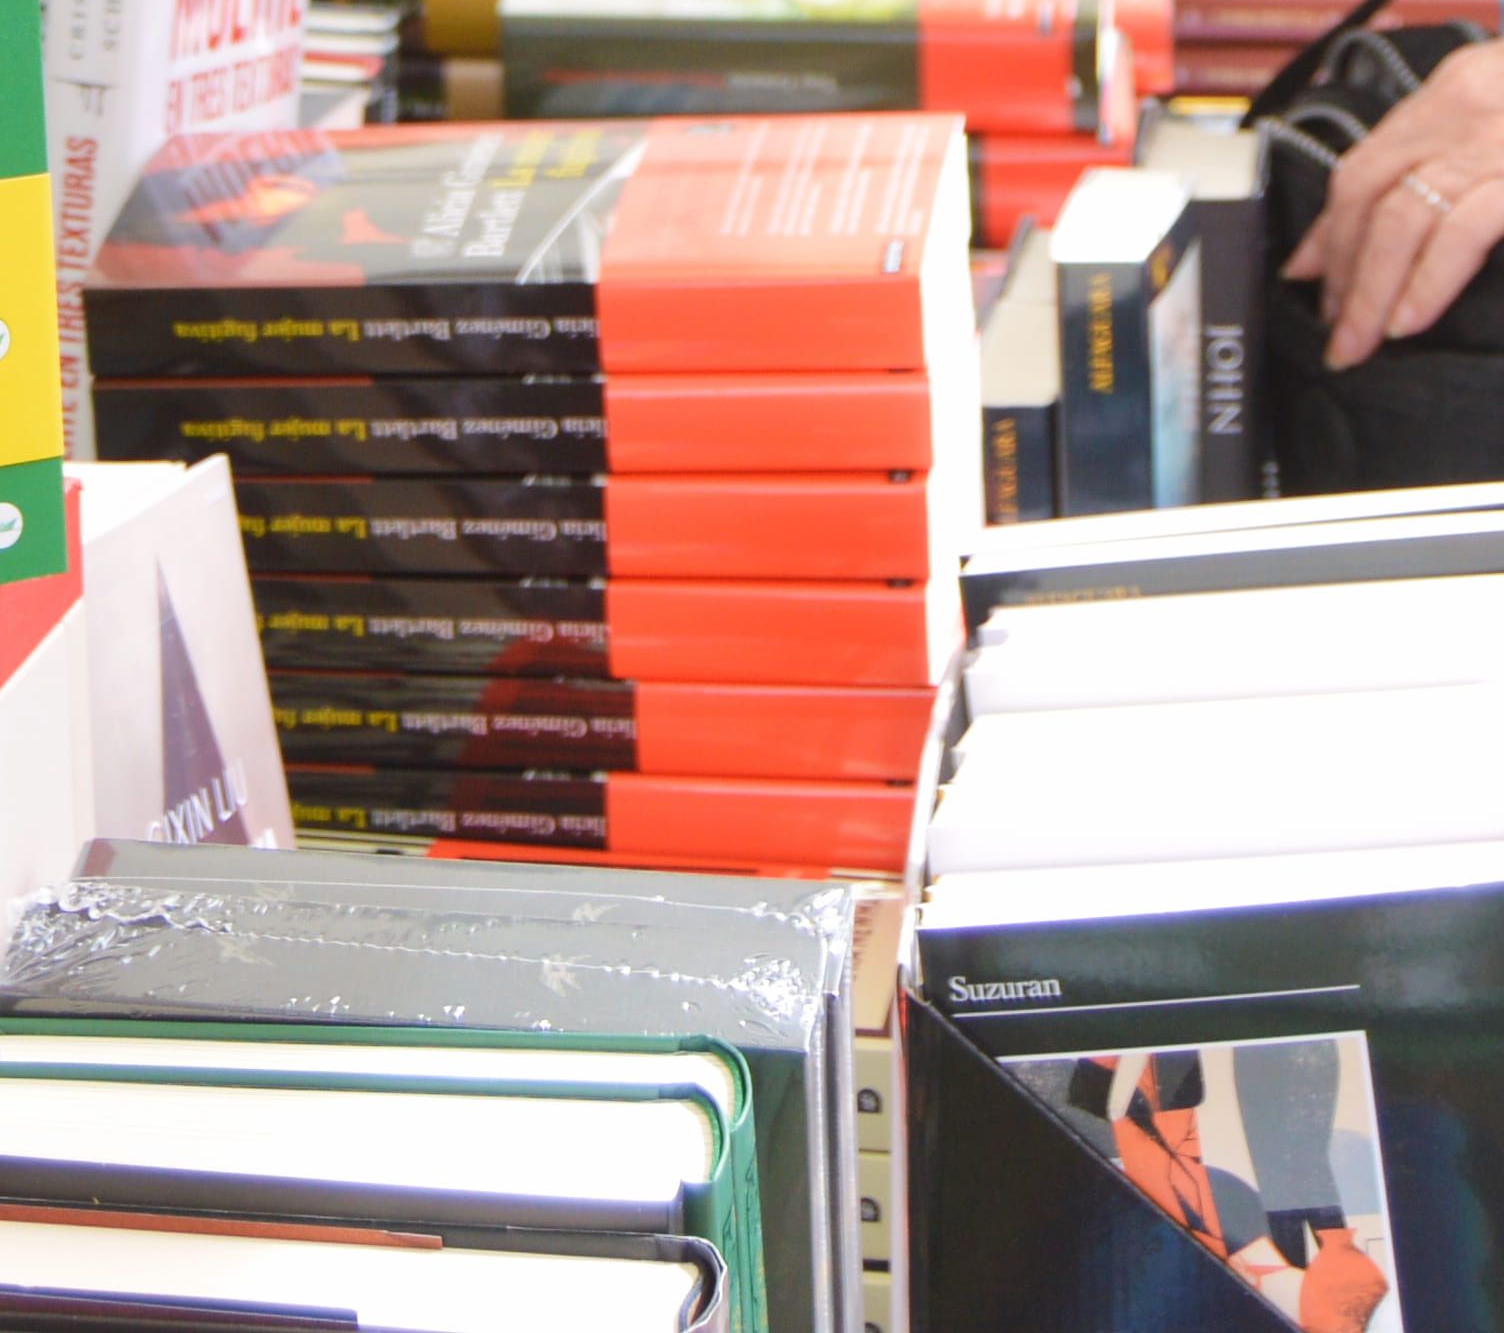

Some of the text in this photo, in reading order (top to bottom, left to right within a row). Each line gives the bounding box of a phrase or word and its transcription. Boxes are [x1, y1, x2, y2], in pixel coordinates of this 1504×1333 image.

[57, 137, 99, 272] TEXTURAS
[56, 283, 84, 345] TRES
[173, 318, 551, 342] Giménez Bartlett La mujer fugitiva
[1089, 274, 1113, 394] ALFAGUARA
[1204, 324, 1244, 434] JOHN
[146, 788, 215, 844] CIXIN
[212, 760, 248, 822] LIU
[949, 974, 1061, 1003] Suzuran
